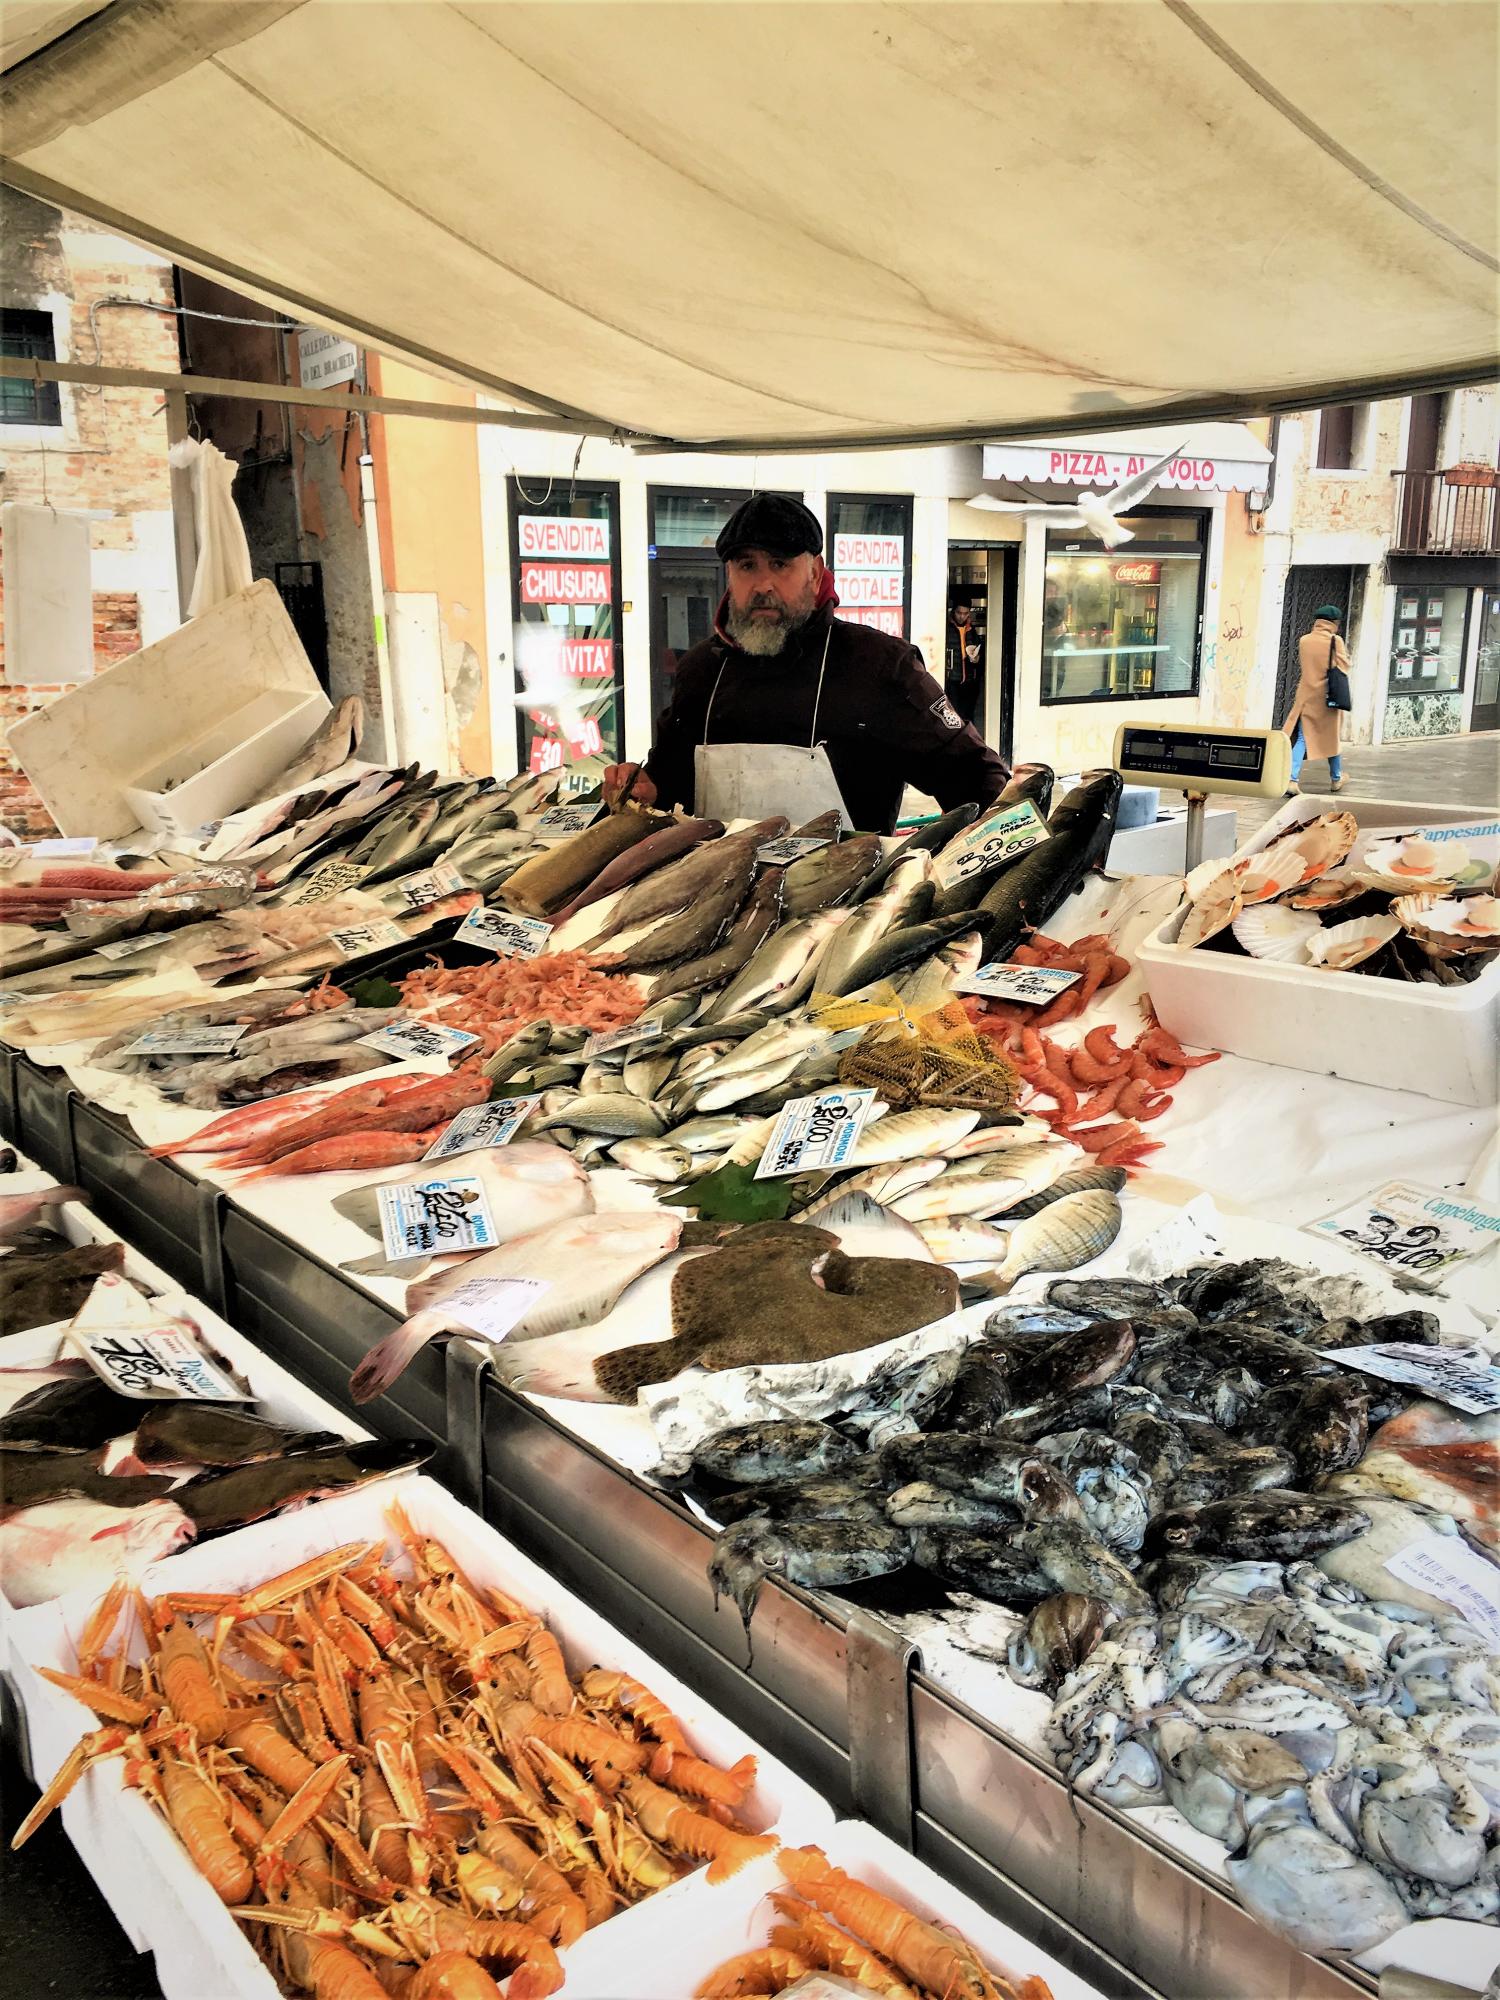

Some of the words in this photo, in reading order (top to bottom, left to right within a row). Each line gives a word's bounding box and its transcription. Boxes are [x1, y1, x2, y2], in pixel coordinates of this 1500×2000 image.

[1050, 451, 1107, 477] PIZZA
[523, 522, 605, 552] SVENDITA
[837, 540, 900, 565] SVENDITA
[525, 568, 608, 599] CHIUSURA
[838, 577, 900, 601] TOTALE
[833, 1121, 856, 1163] MORMORA
[472, 1214, 489, 1243] ROMBO
